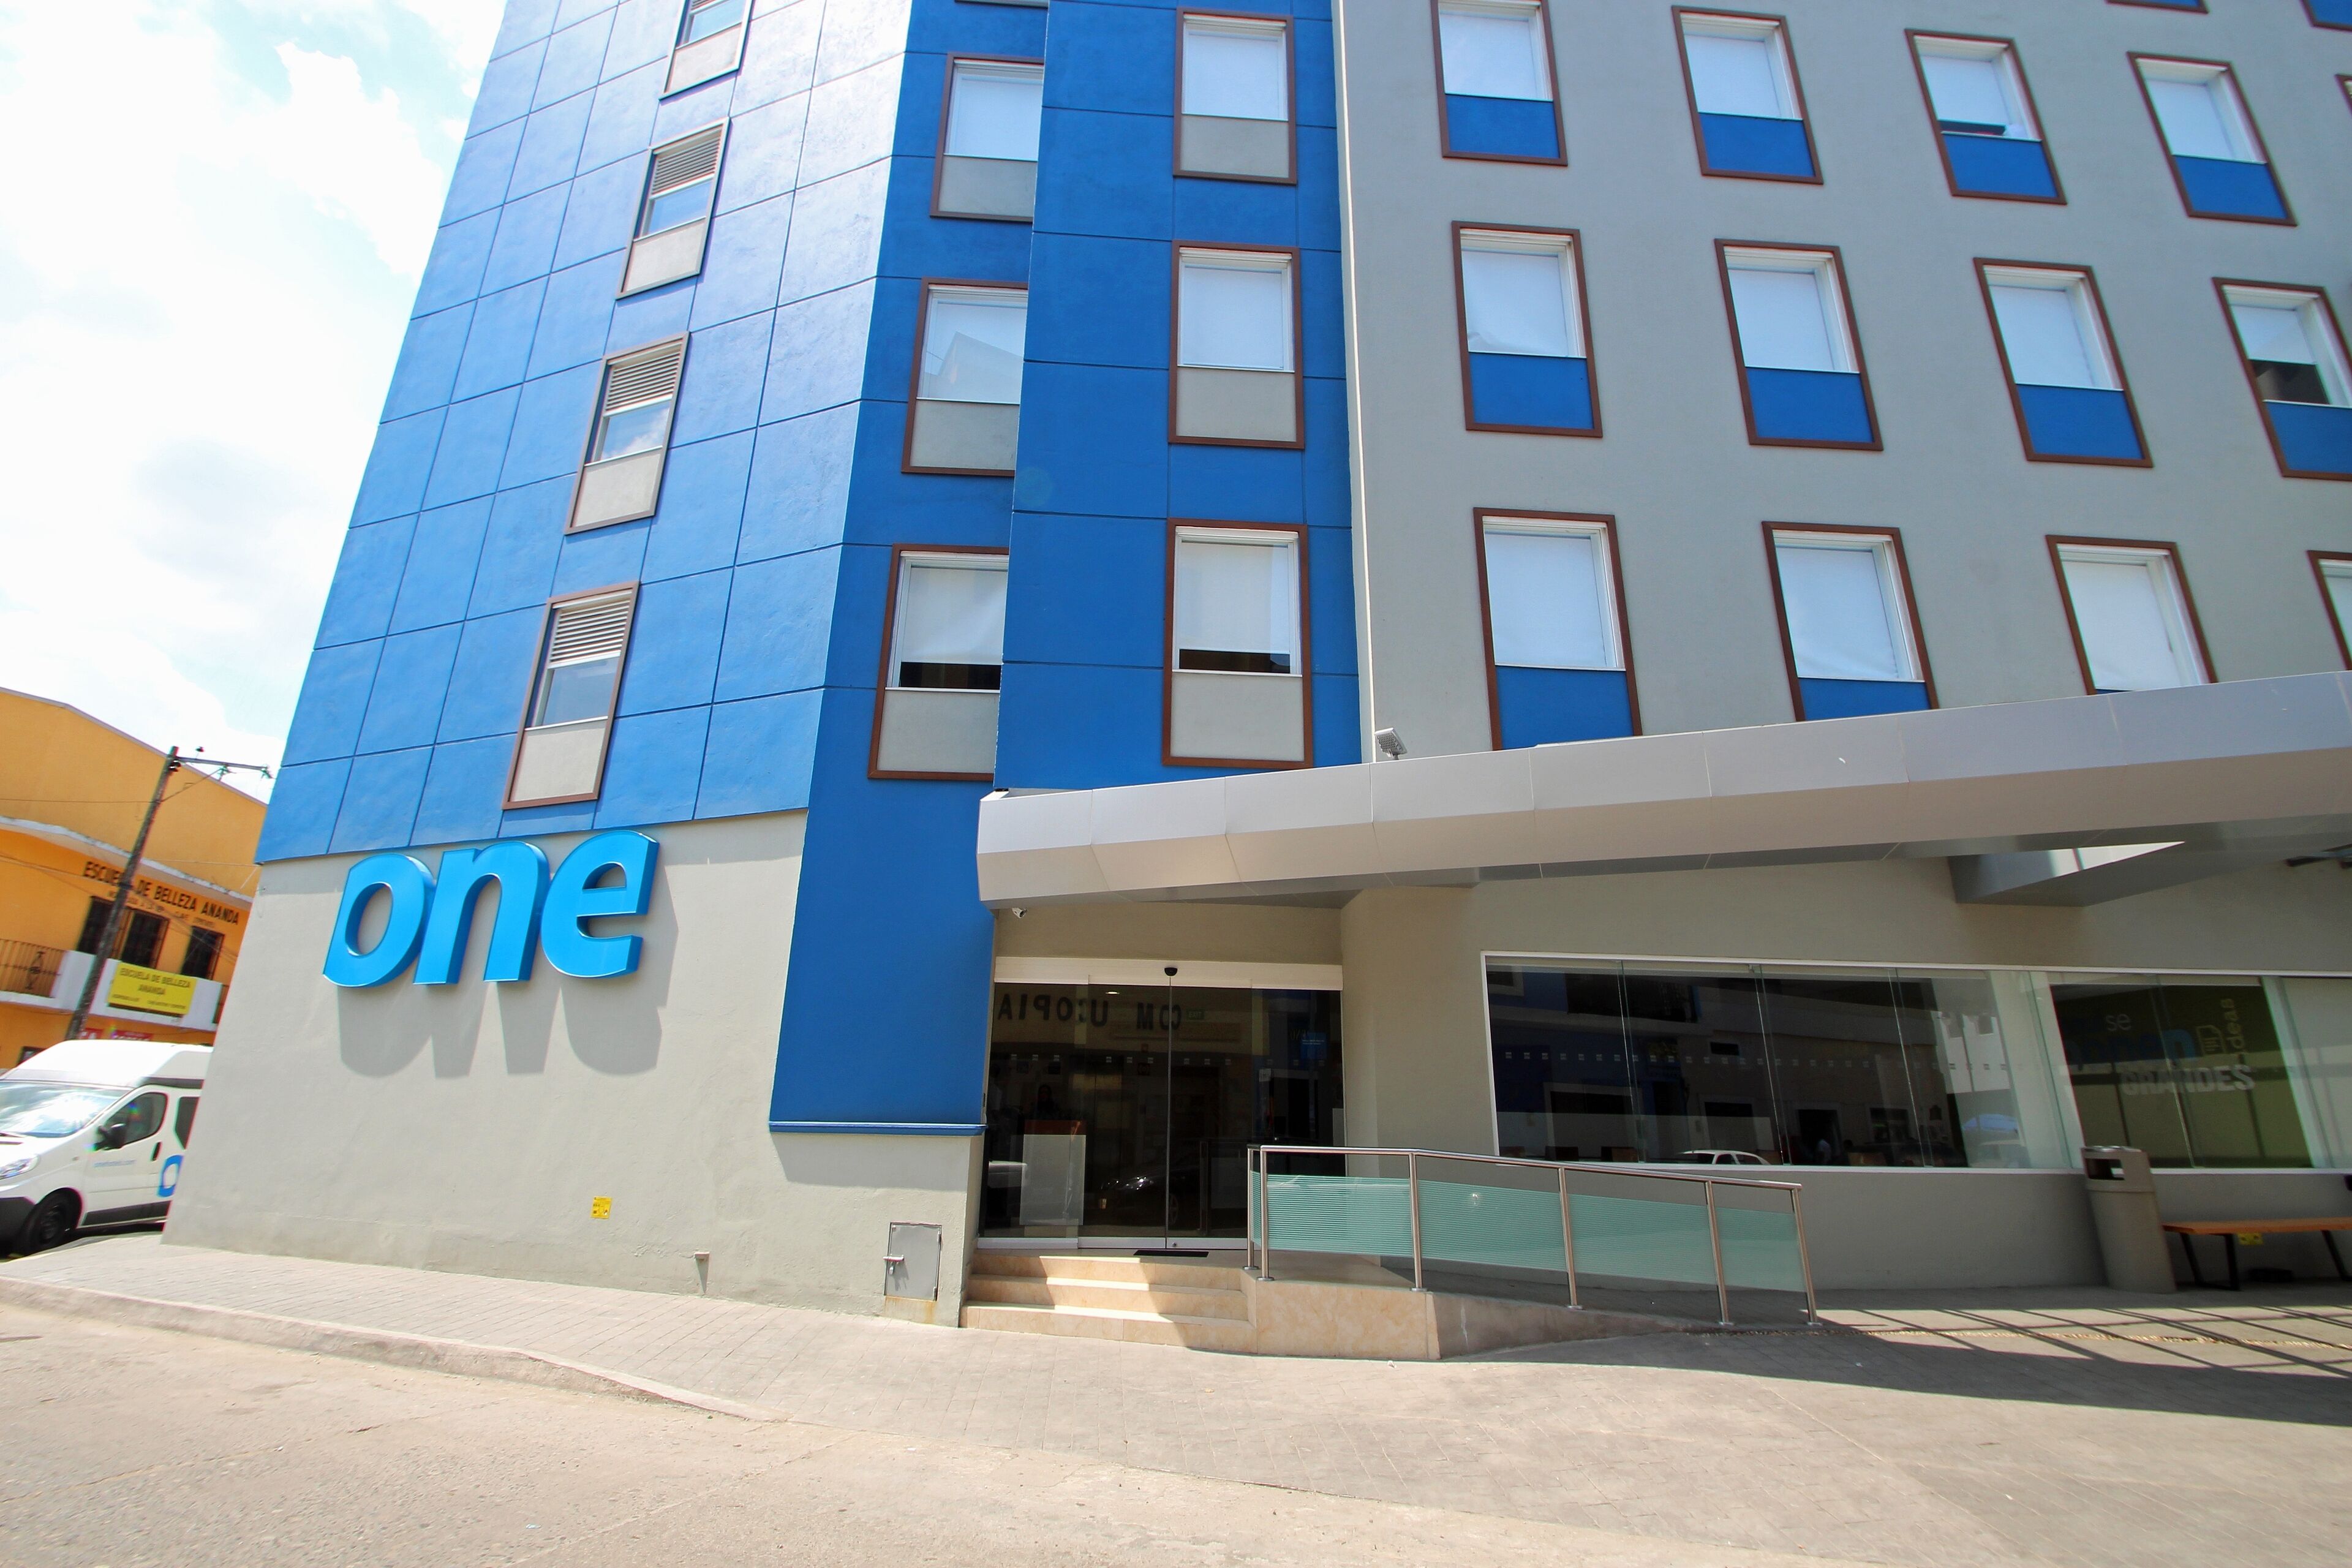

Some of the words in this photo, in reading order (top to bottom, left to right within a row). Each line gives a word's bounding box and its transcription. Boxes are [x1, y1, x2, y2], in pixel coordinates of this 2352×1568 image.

[83, 861, 126, 886] ESCUE
[137, 880, 152, 897] DE
[154, 886, 197, 911] BELLEZA
[201, 902, 239, 925] ANANDA
[323, 830, 660, 987] one
[120, 968, 149, 980] ESCUELA
[151, 974, 160, 983] DE
[161, 976, 190, 988] BELLEZA
[2106, 1012, 2132, 1032] se
[2120, 1064, 2256, 1096] GRANDES
